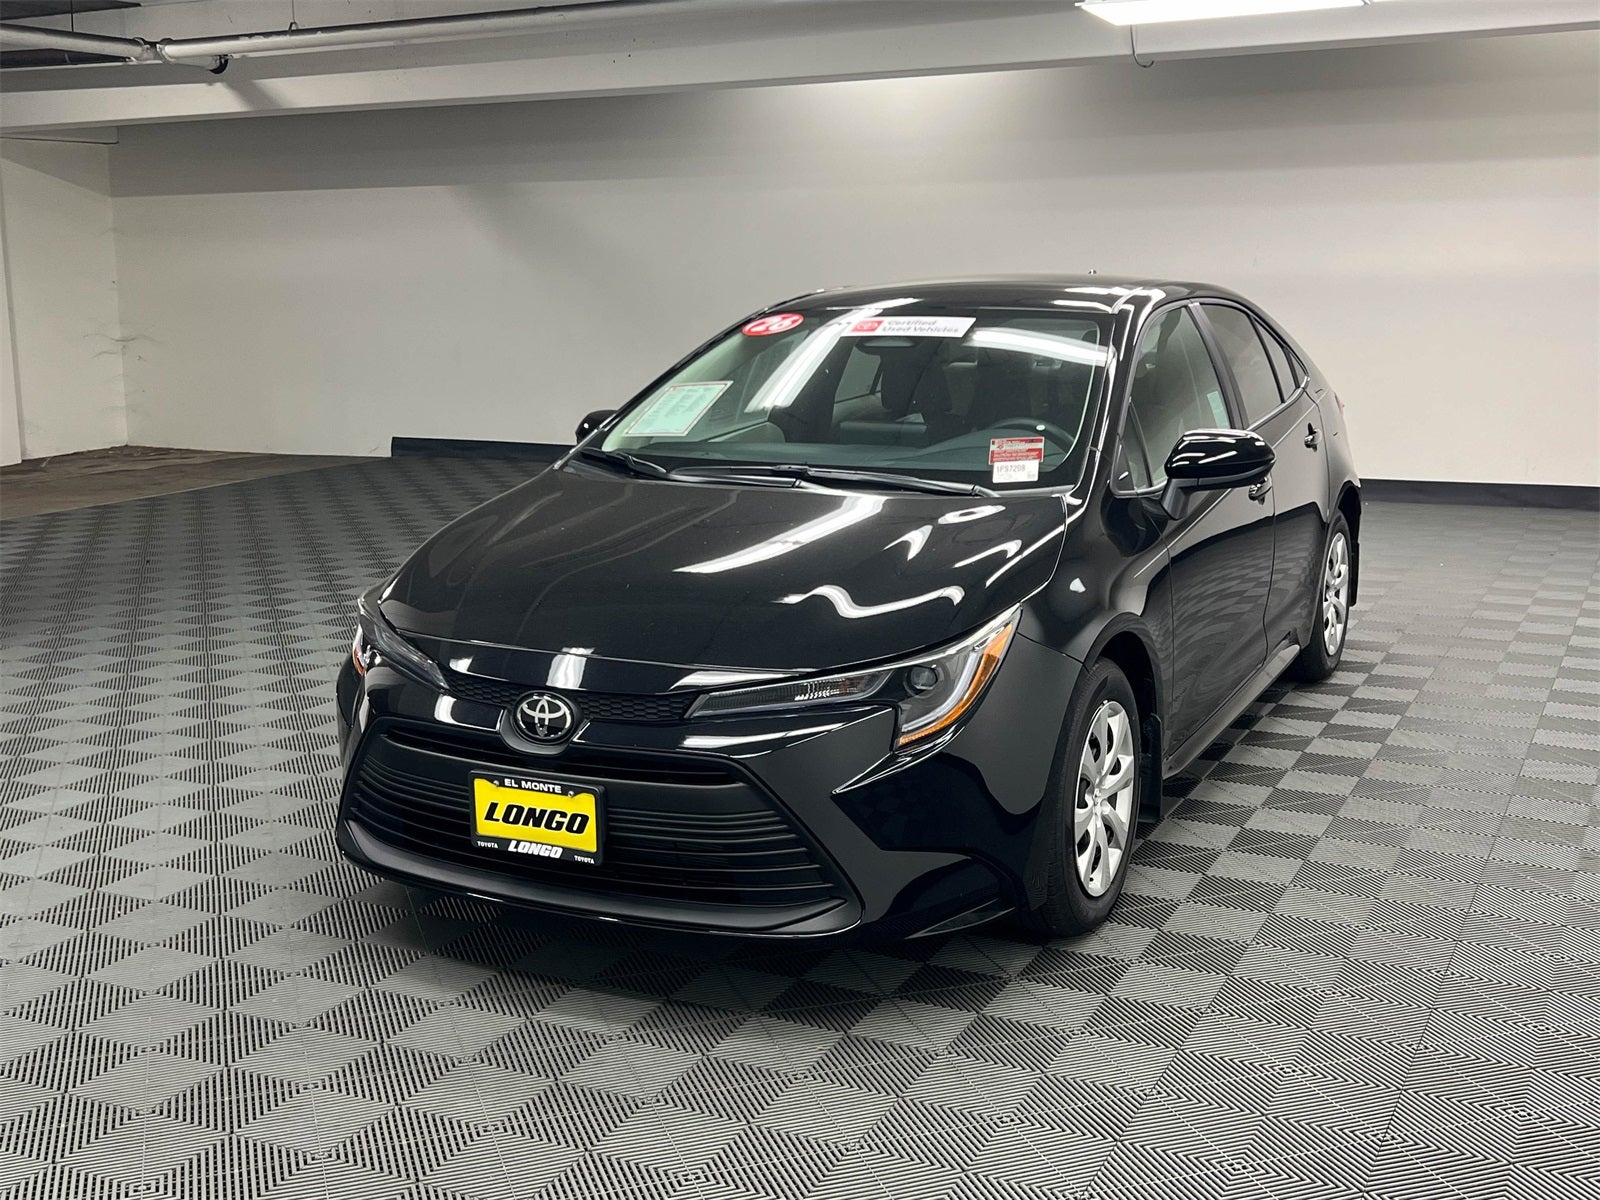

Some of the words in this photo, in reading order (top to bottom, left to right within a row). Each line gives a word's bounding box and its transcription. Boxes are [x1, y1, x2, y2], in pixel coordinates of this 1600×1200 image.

[887, 319, 938, 327] Certified
[914, 326, 960, 334] Vehicles
[504, 778, 518, 788] EL
[521, 780, 562, 794] MONTE
[484, 802, 590, 834] LONGO
[477, 840, 499, 849] TOYOTA
[508, 840, 563, 859] LONGO
[574, 855, 595, 864] TOYOTA
